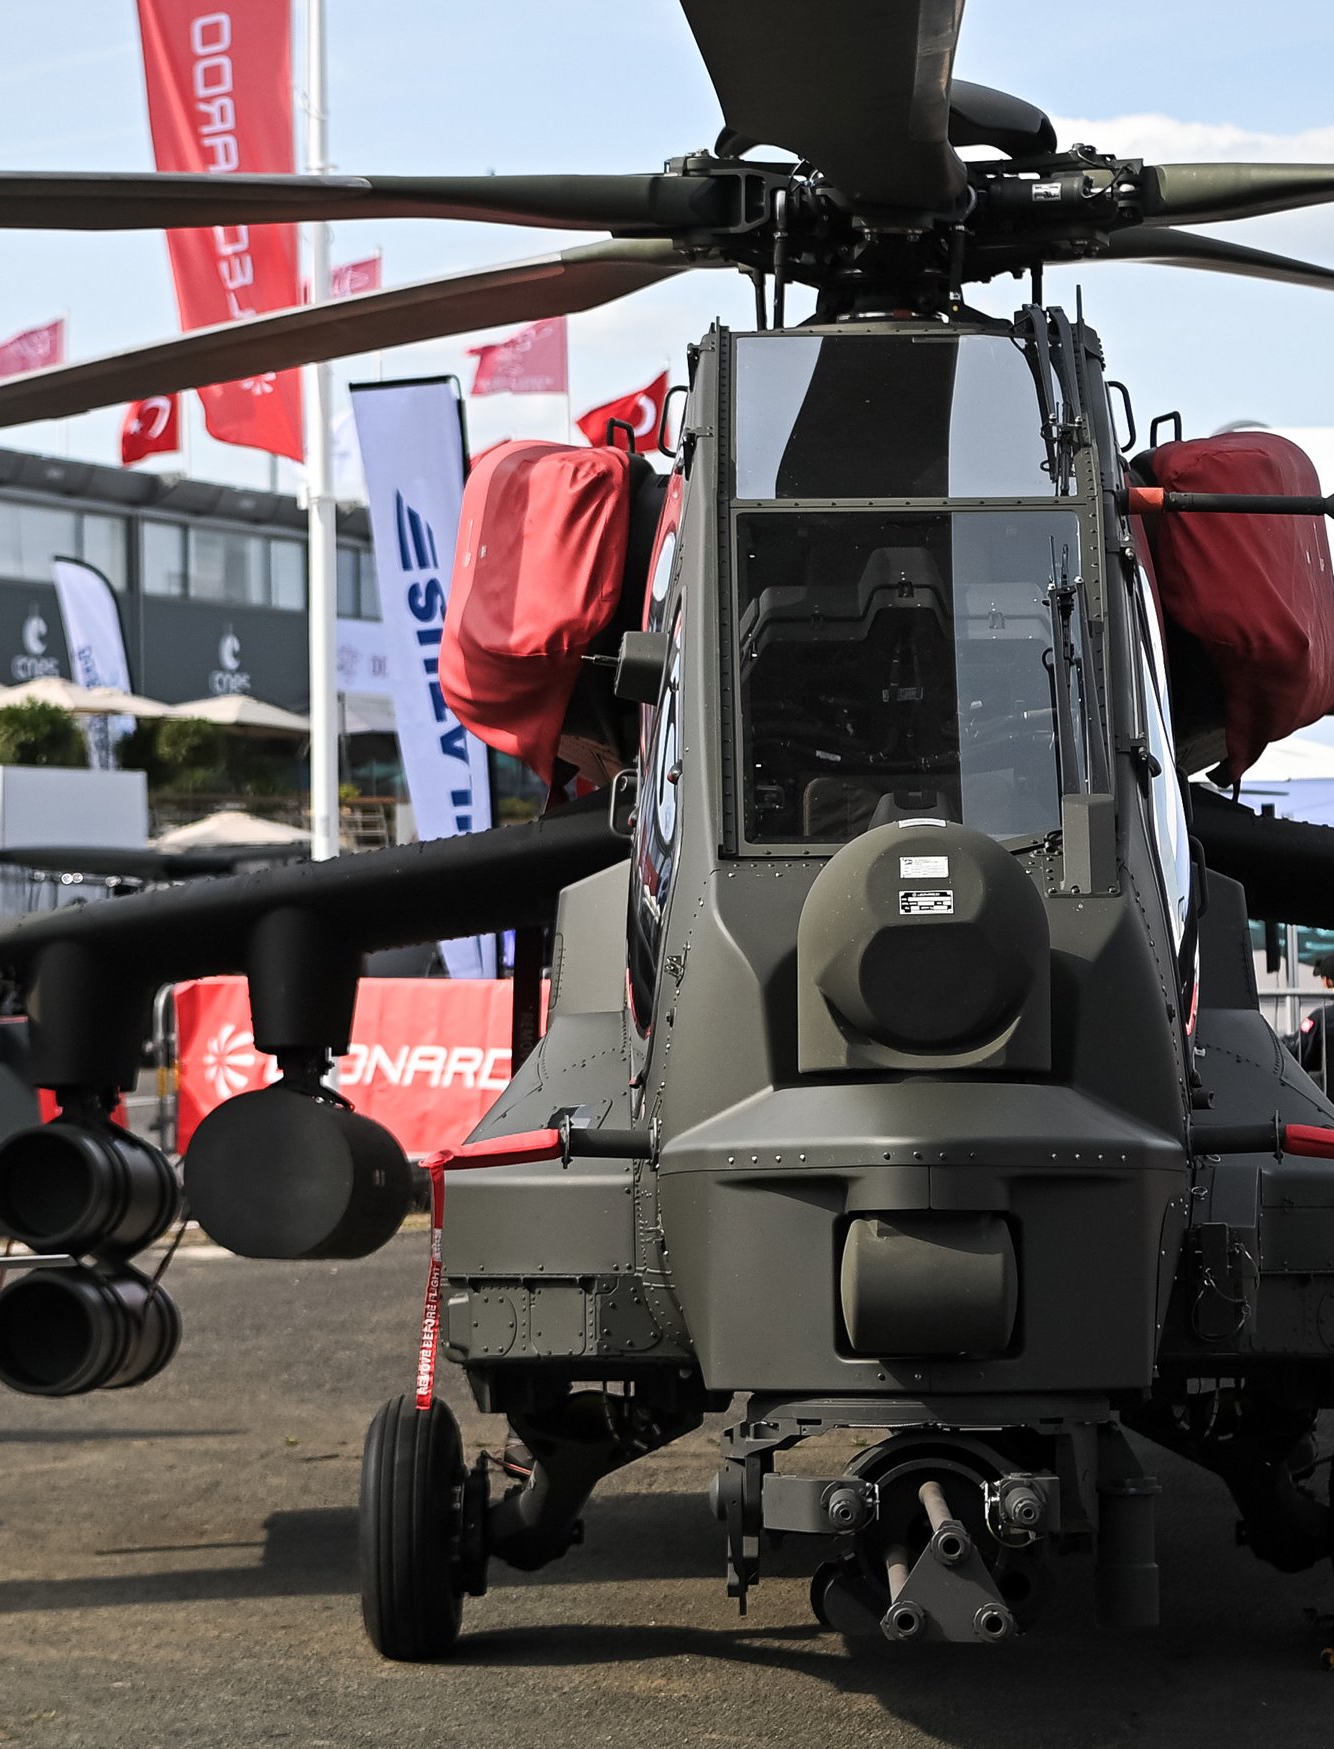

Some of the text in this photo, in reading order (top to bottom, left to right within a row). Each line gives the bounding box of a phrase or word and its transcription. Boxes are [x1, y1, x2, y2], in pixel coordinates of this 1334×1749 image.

[428, 1265, 442, 1303] FLIGHT
[422, 1304, 438, 1349] BEFORE
[417, 1349, 433, 1396] REMOVE
